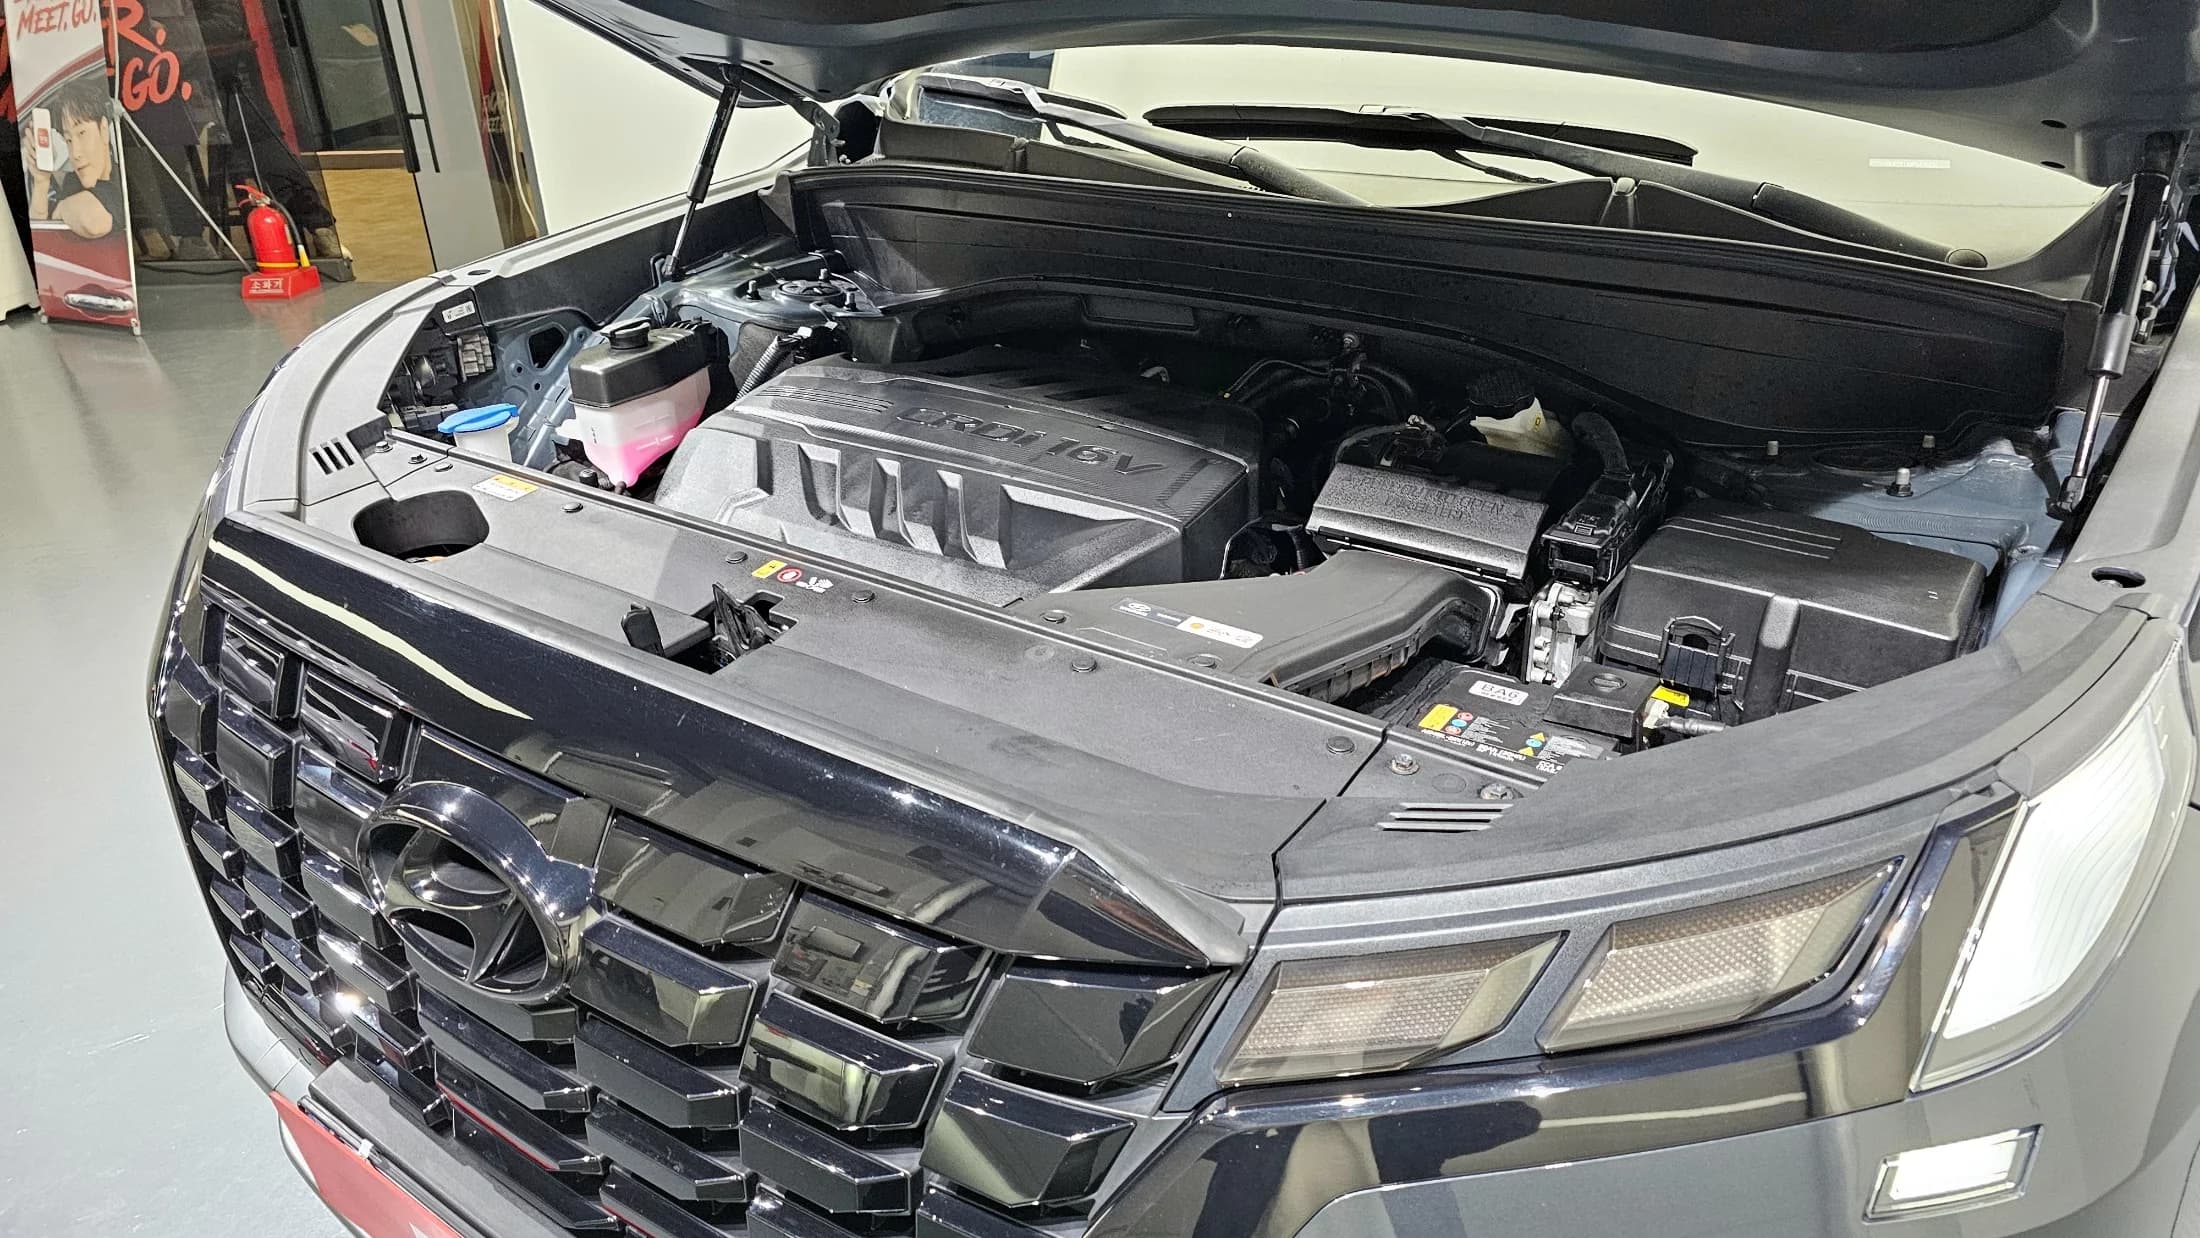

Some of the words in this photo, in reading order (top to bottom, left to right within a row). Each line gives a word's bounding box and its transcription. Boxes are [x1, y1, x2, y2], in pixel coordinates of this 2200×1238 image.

[17, 2, 69, 41] MEET.
[122, 51, 192, 111] GO.
[251, 279, 283, 290] 소화기
[1046, 436, 1168, 475] 16V
